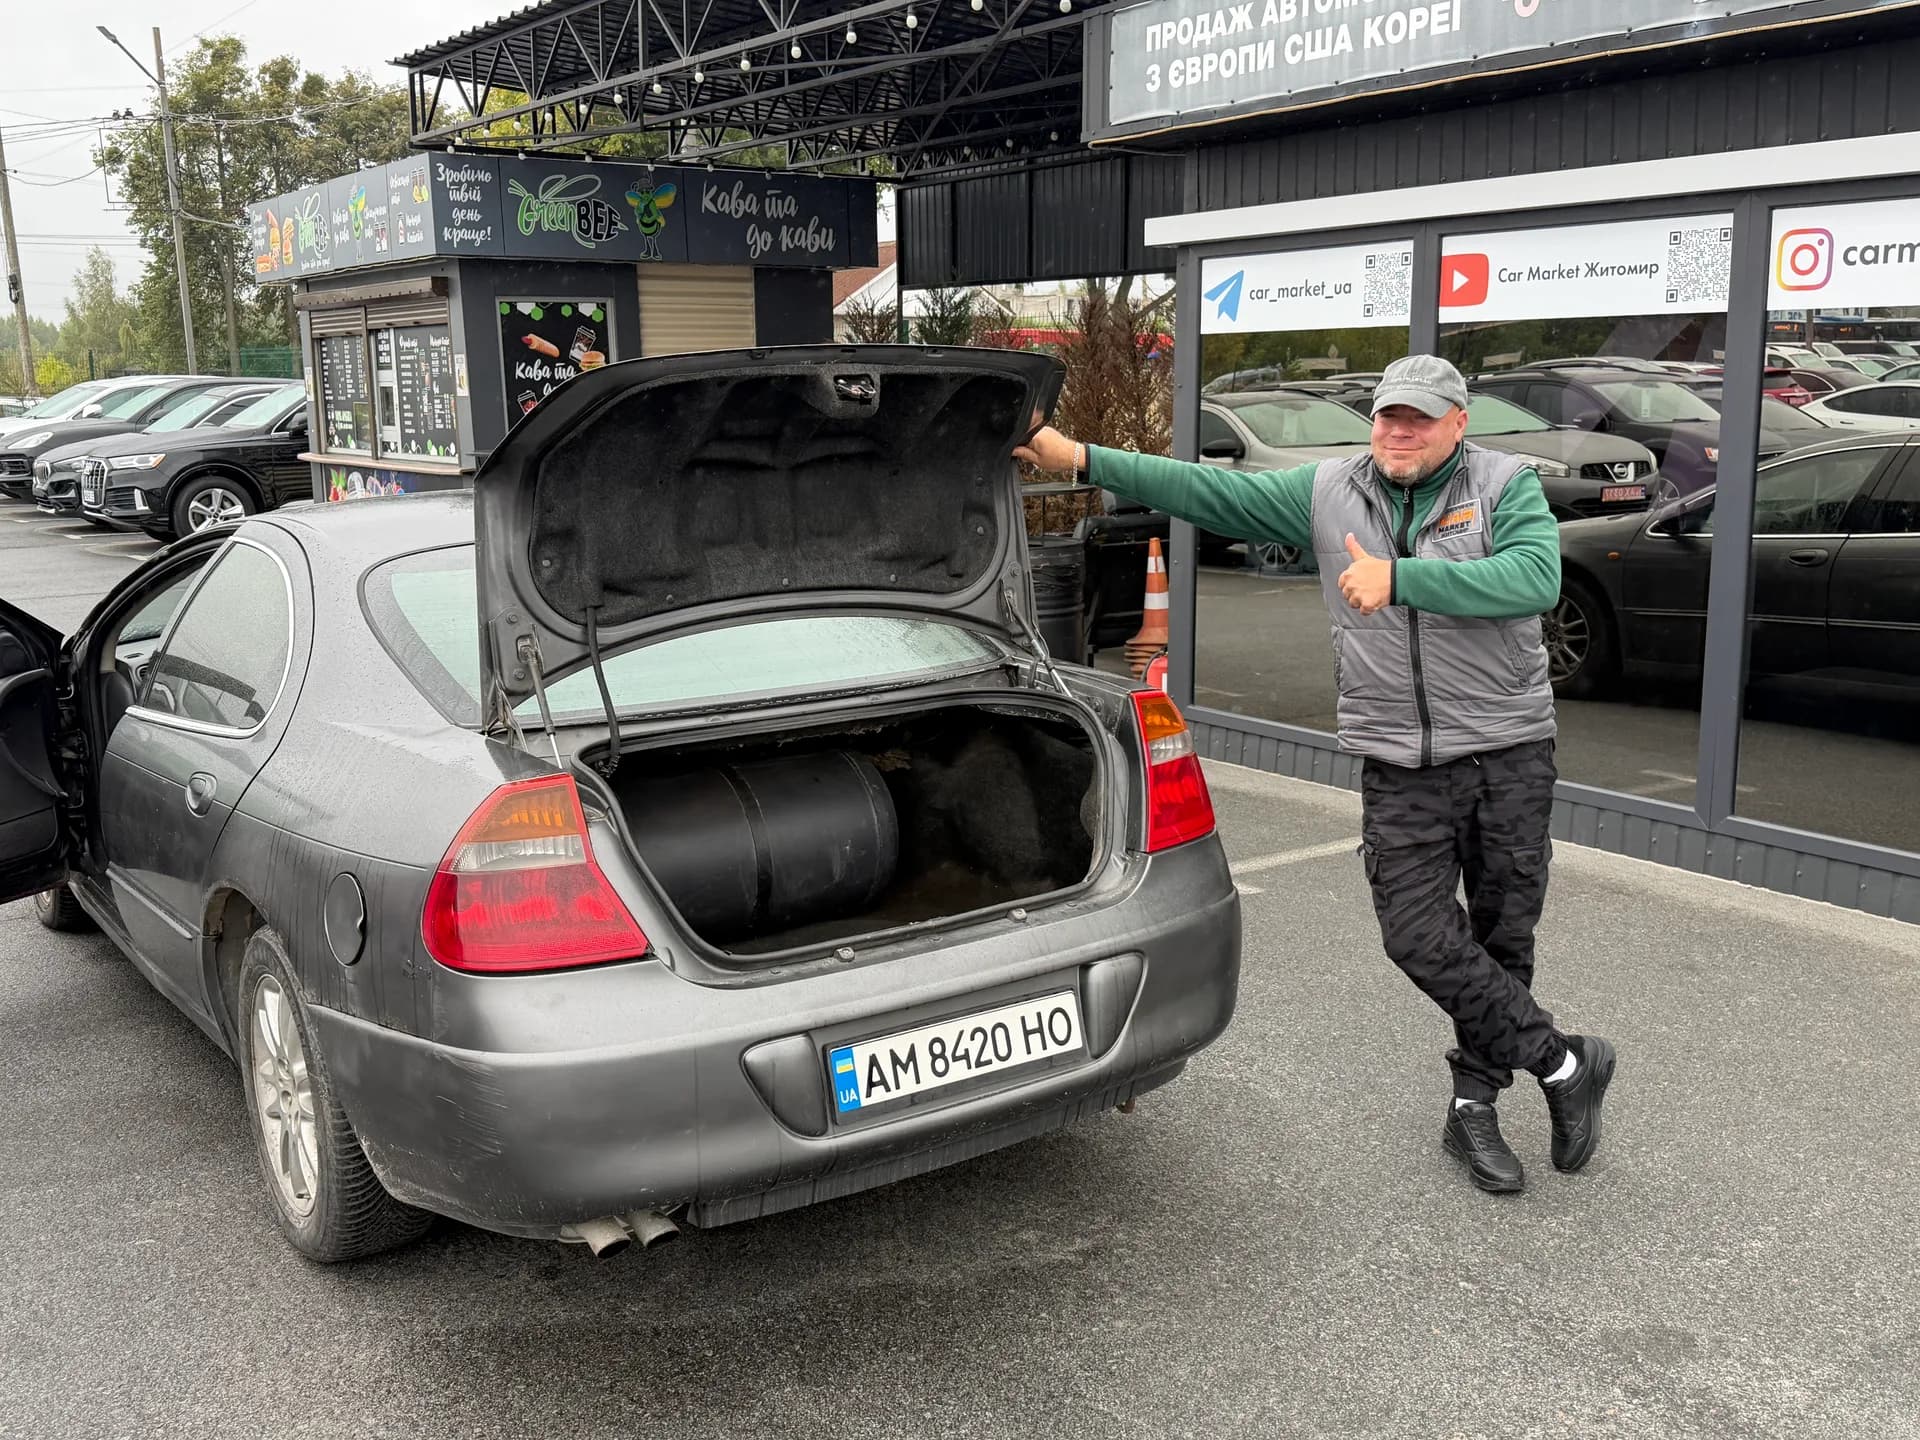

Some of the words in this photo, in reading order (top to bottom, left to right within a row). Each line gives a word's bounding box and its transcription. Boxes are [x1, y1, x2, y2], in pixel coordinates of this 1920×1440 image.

[1145, 3, 1254, 53] ПРОДАЖ
[1145, 63, 1161, 93] З
[1168, 39, 1275, 89] ЄВРОПИ
[1284, 23, 1354, 65] США
[436, 162, 493, 189] Зробимо
[449, 183, 482, 203] твій
[701, 179, 760, 219] Кава
[764, 190, 799, 220] та
[452, 207, 482, 227] день
[443, 226, 492, 249] краще!
[746, 223, 773, 260] до
[779, 216, 837, 253] кави
[1497, 267, 1524, 283] Car
[1527, 262, 1580, 282] Market
[1584, 260, 1660, 280] Житомир
[1249, 278, 1353, 303] car_market_ua
[514, 358, 553, 382] Кава
[554, 362, 577, 380] та
[865, 1043, 921, 1099] AM
[928, 1022, 1013, 1078] 8420
[1020, 1006, 1073, 1055] HO
[840, 1087, 859, 1104] UA
